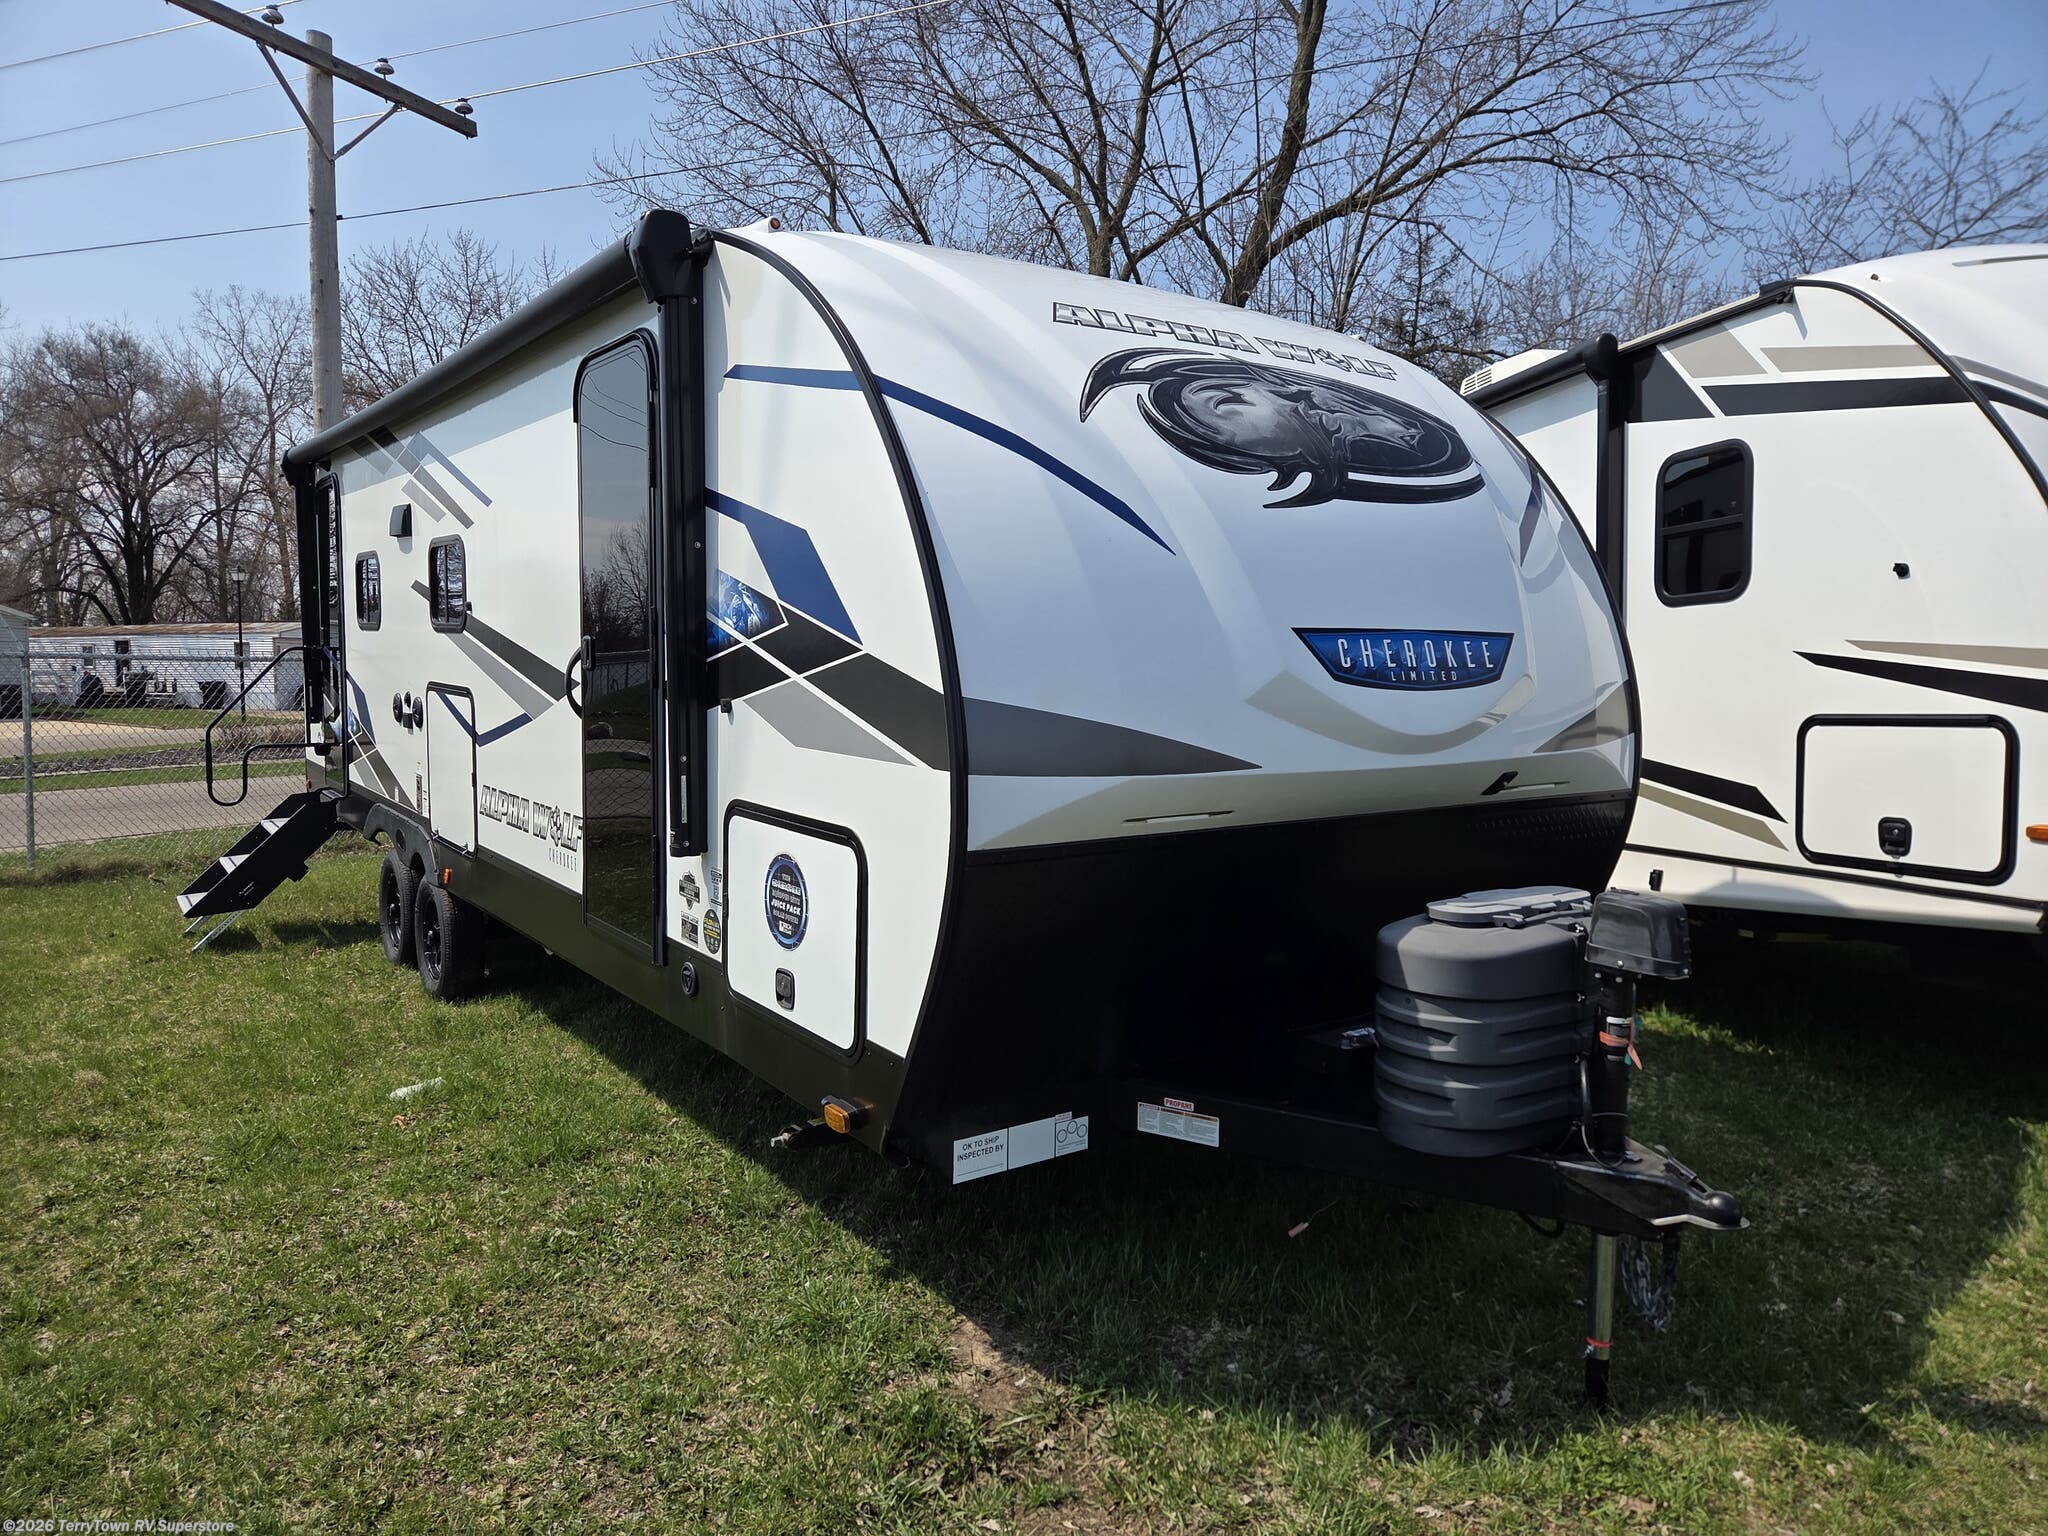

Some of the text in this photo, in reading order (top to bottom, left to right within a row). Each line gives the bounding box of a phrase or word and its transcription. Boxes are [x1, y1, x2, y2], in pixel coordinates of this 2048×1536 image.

[1052, 301, 1260, 354] ALPHA
[1338, 637, 1495, 669] CHEROKEE
[1390, 670, 1459, 682] LIMITED
[480, 784, 530, 834] ALPHA
[771, 898, 801, 916] JUICE PACK
[1165, 1098, 1193, 1110] PROPANE
[962, 1135, 999, 1151] OK TO SHIP
[957, 1144, 1004, 1162] INSPECTED BY
